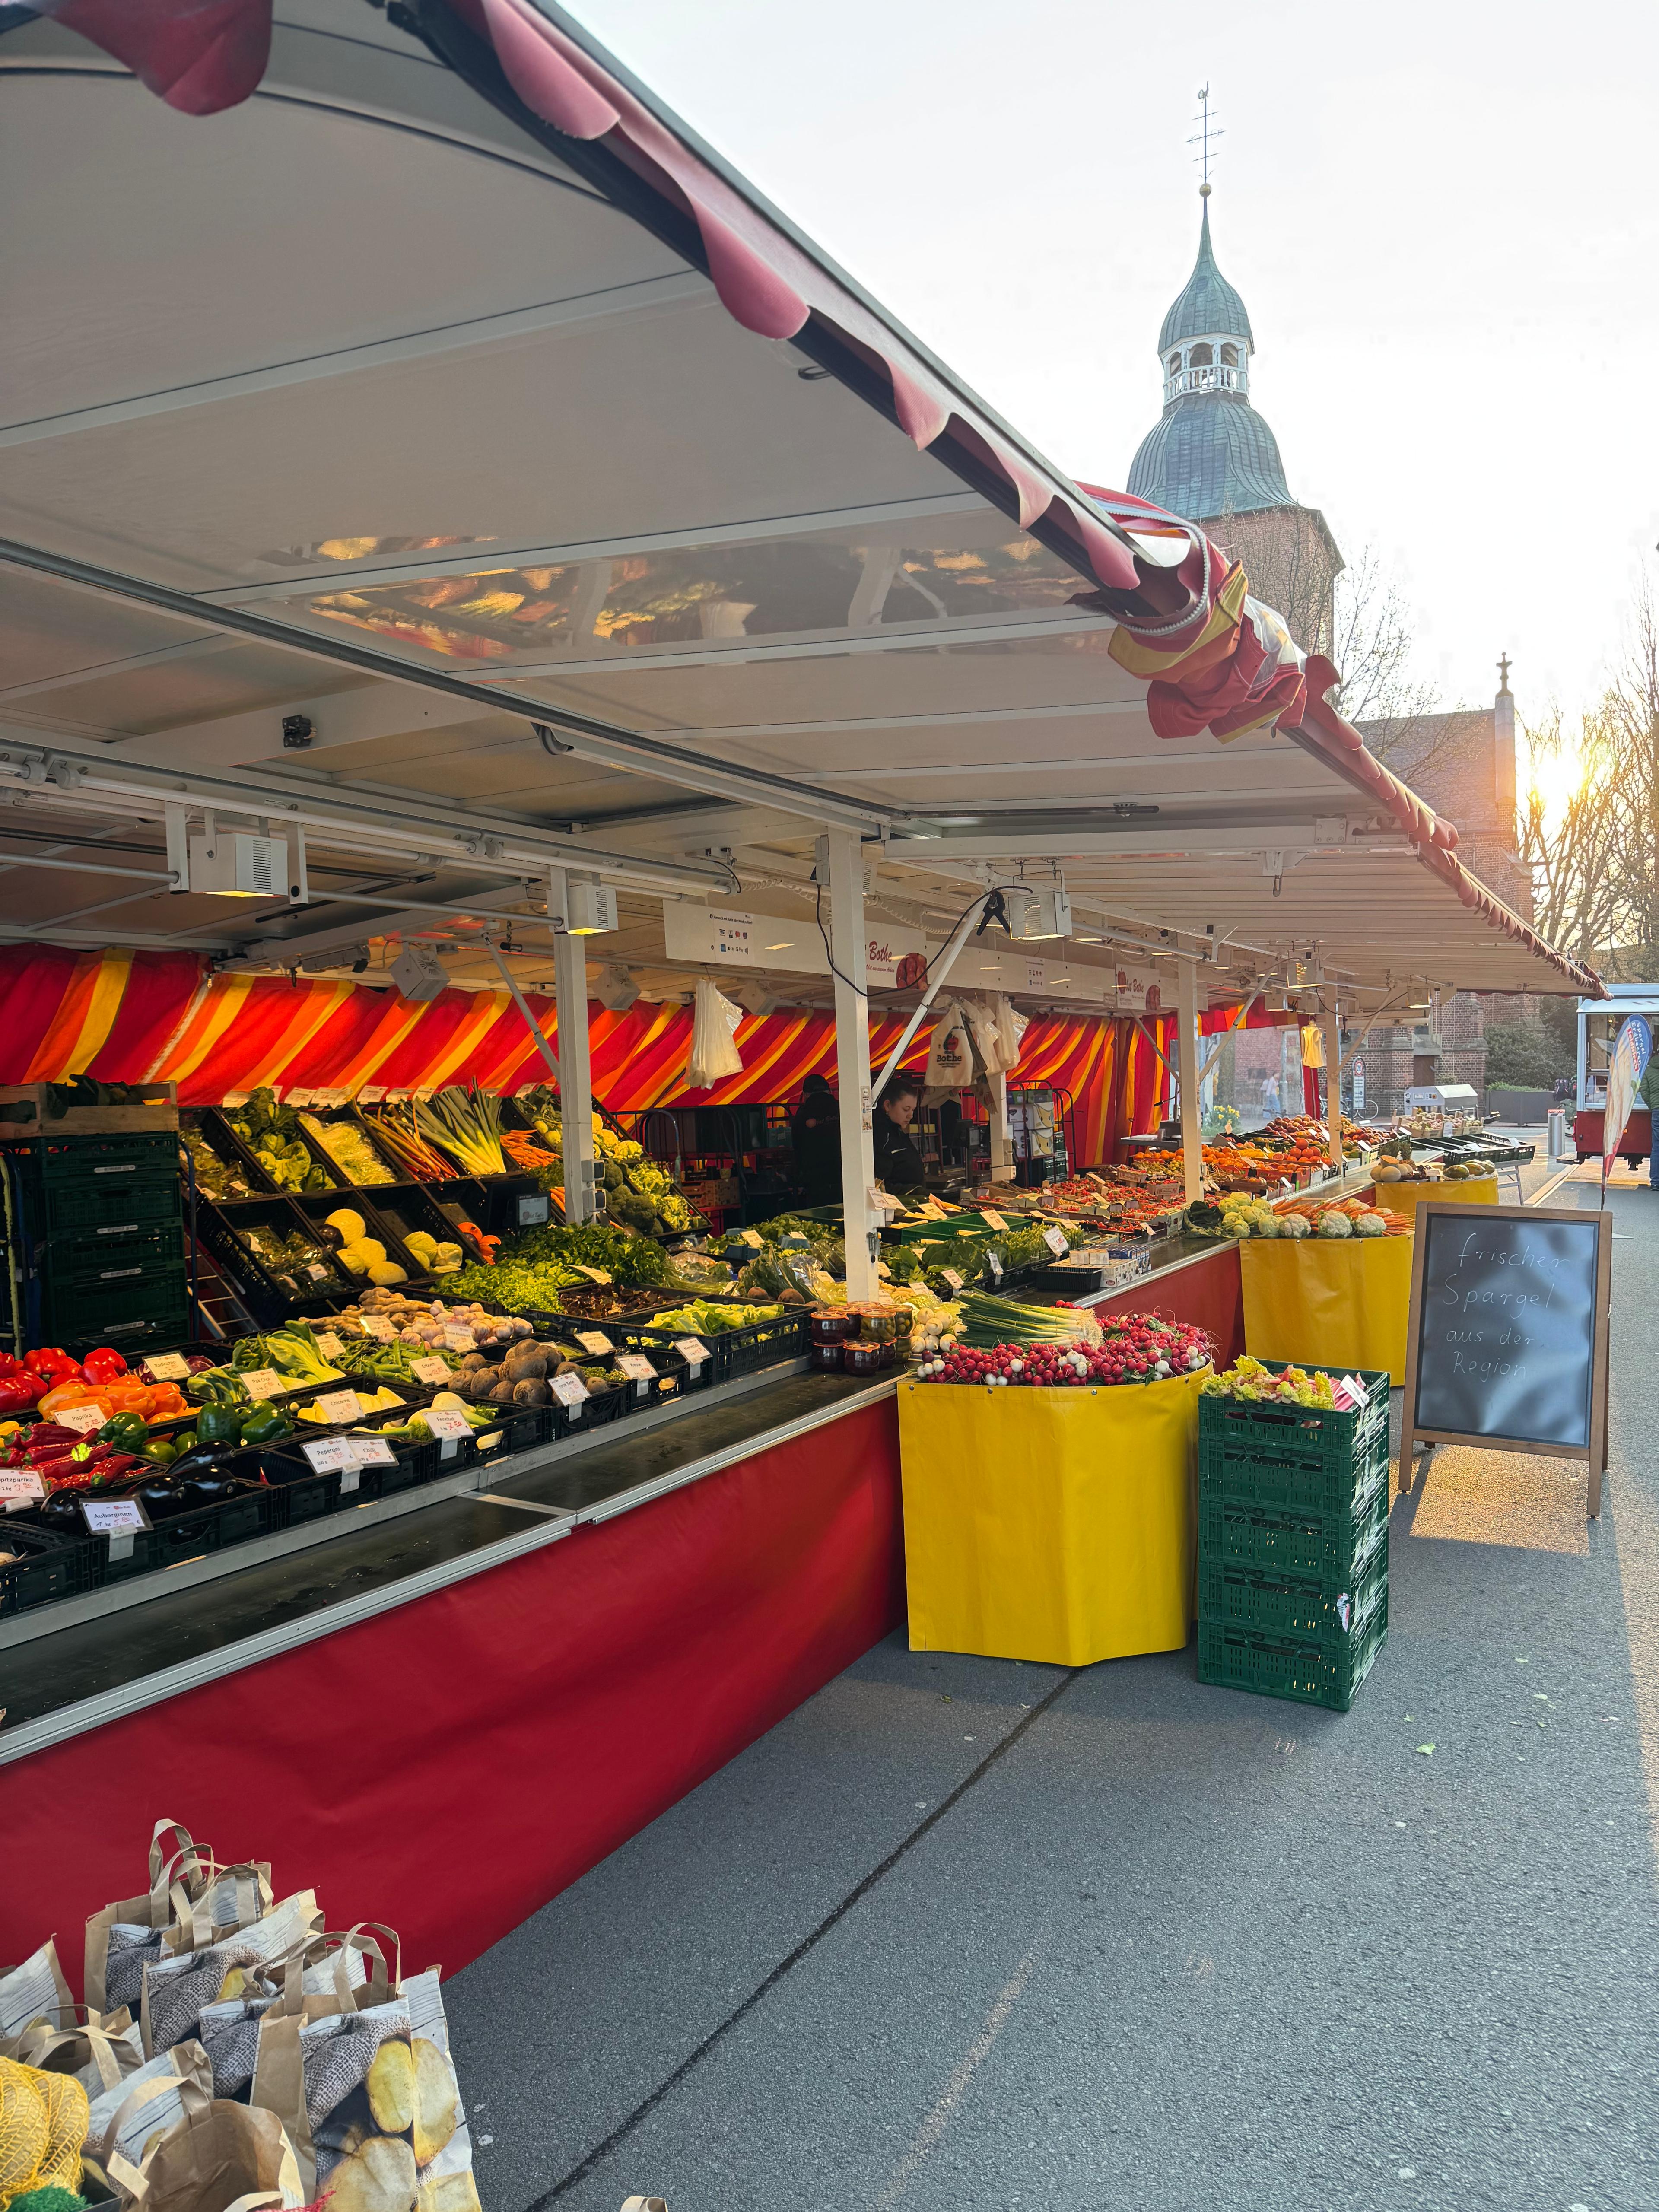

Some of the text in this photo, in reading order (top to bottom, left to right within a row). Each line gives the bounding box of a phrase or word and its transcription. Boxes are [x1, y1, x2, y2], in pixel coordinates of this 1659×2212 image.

[869, 941, 892, 963] Bothe
[1632, 1022, 1642, 1065] Erdbeeren
[1637, 1022, 1646, 1054] Spargel
[1458, 1233, 1570, 1267] frischer
[1443, 1274, 1554, 1319] Spargel
[1446, 1328, 1535, 1344] aus der
[1453, 1351, 1526, 1382] Region
[317, 1446, 340, 1456] Peperoni
